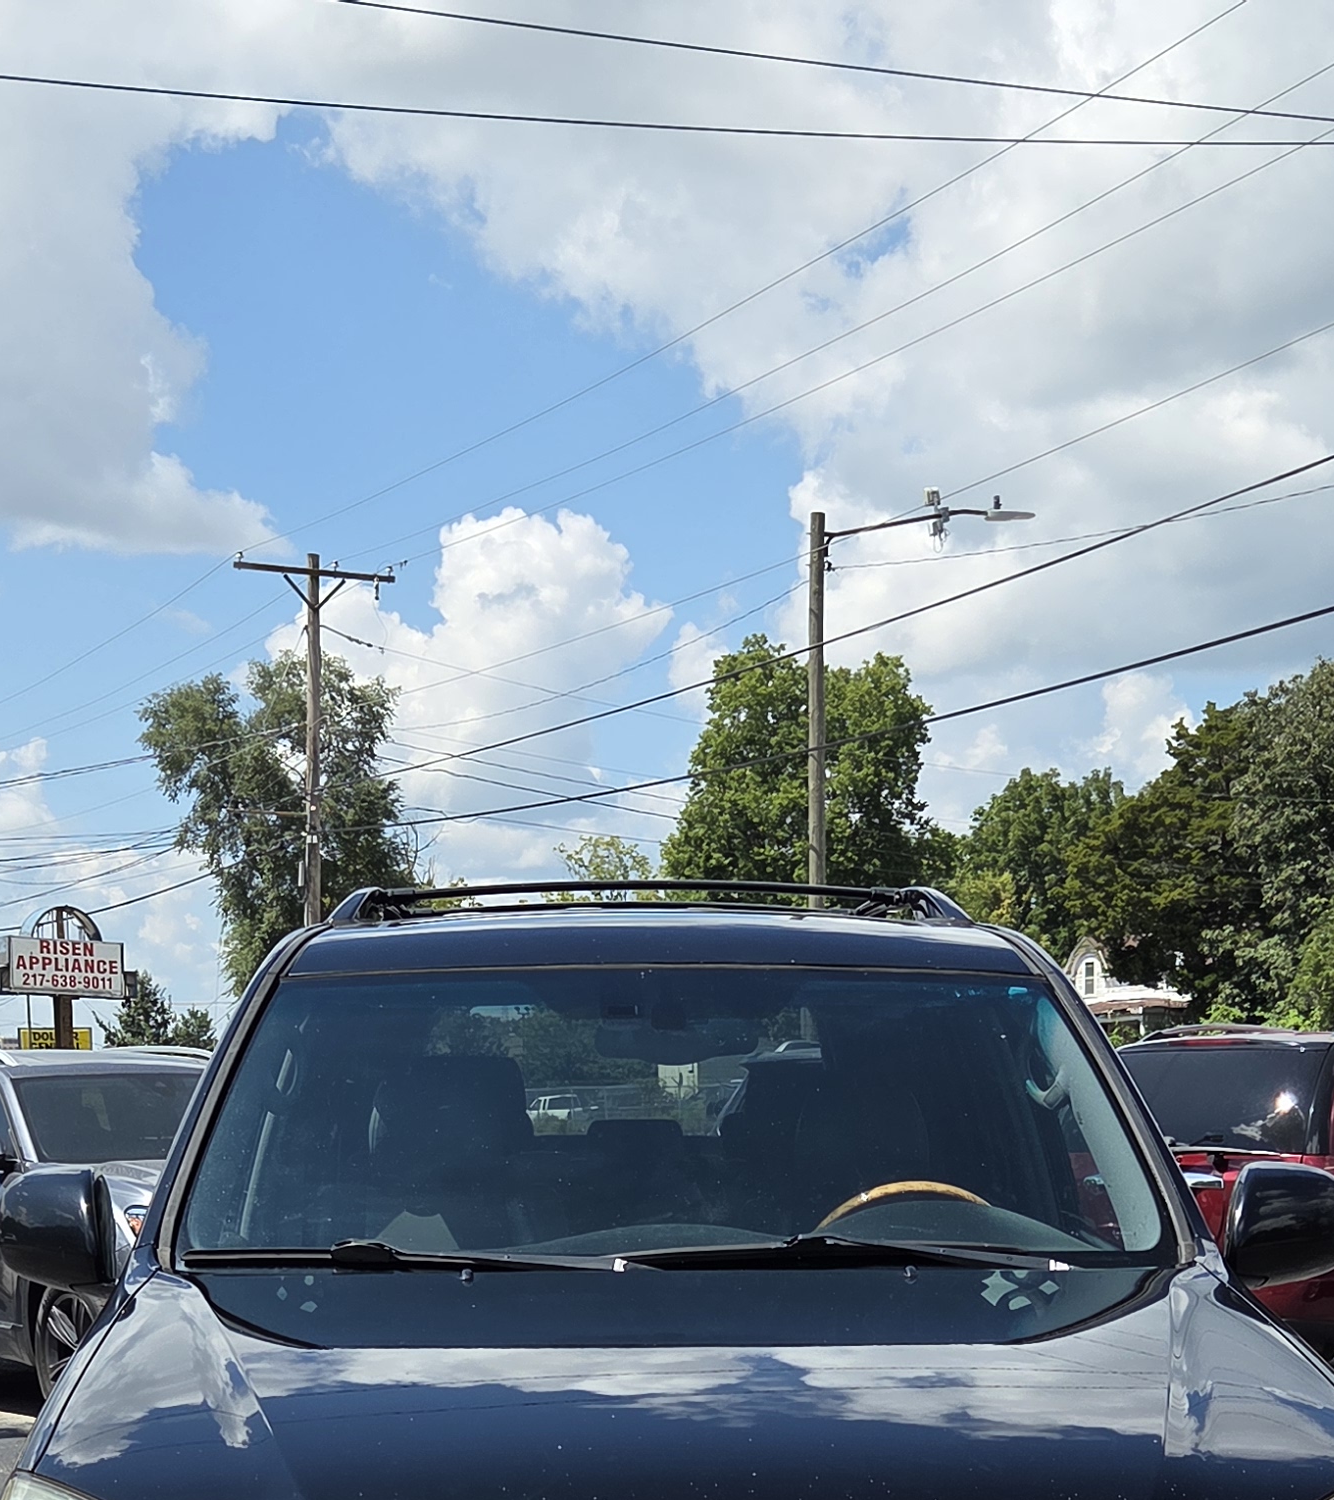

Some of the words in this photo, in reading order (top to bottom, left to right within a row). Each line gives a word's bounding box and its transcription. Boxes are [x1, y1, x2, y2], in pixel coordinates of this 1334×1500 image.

[39, 939, 95, 957] RISEN
[16, 955, 119, 975] APPLIANCE
[22, 973, 113, 990] 217-638-9011
[32, 1031, 80, 1042] DOLR
